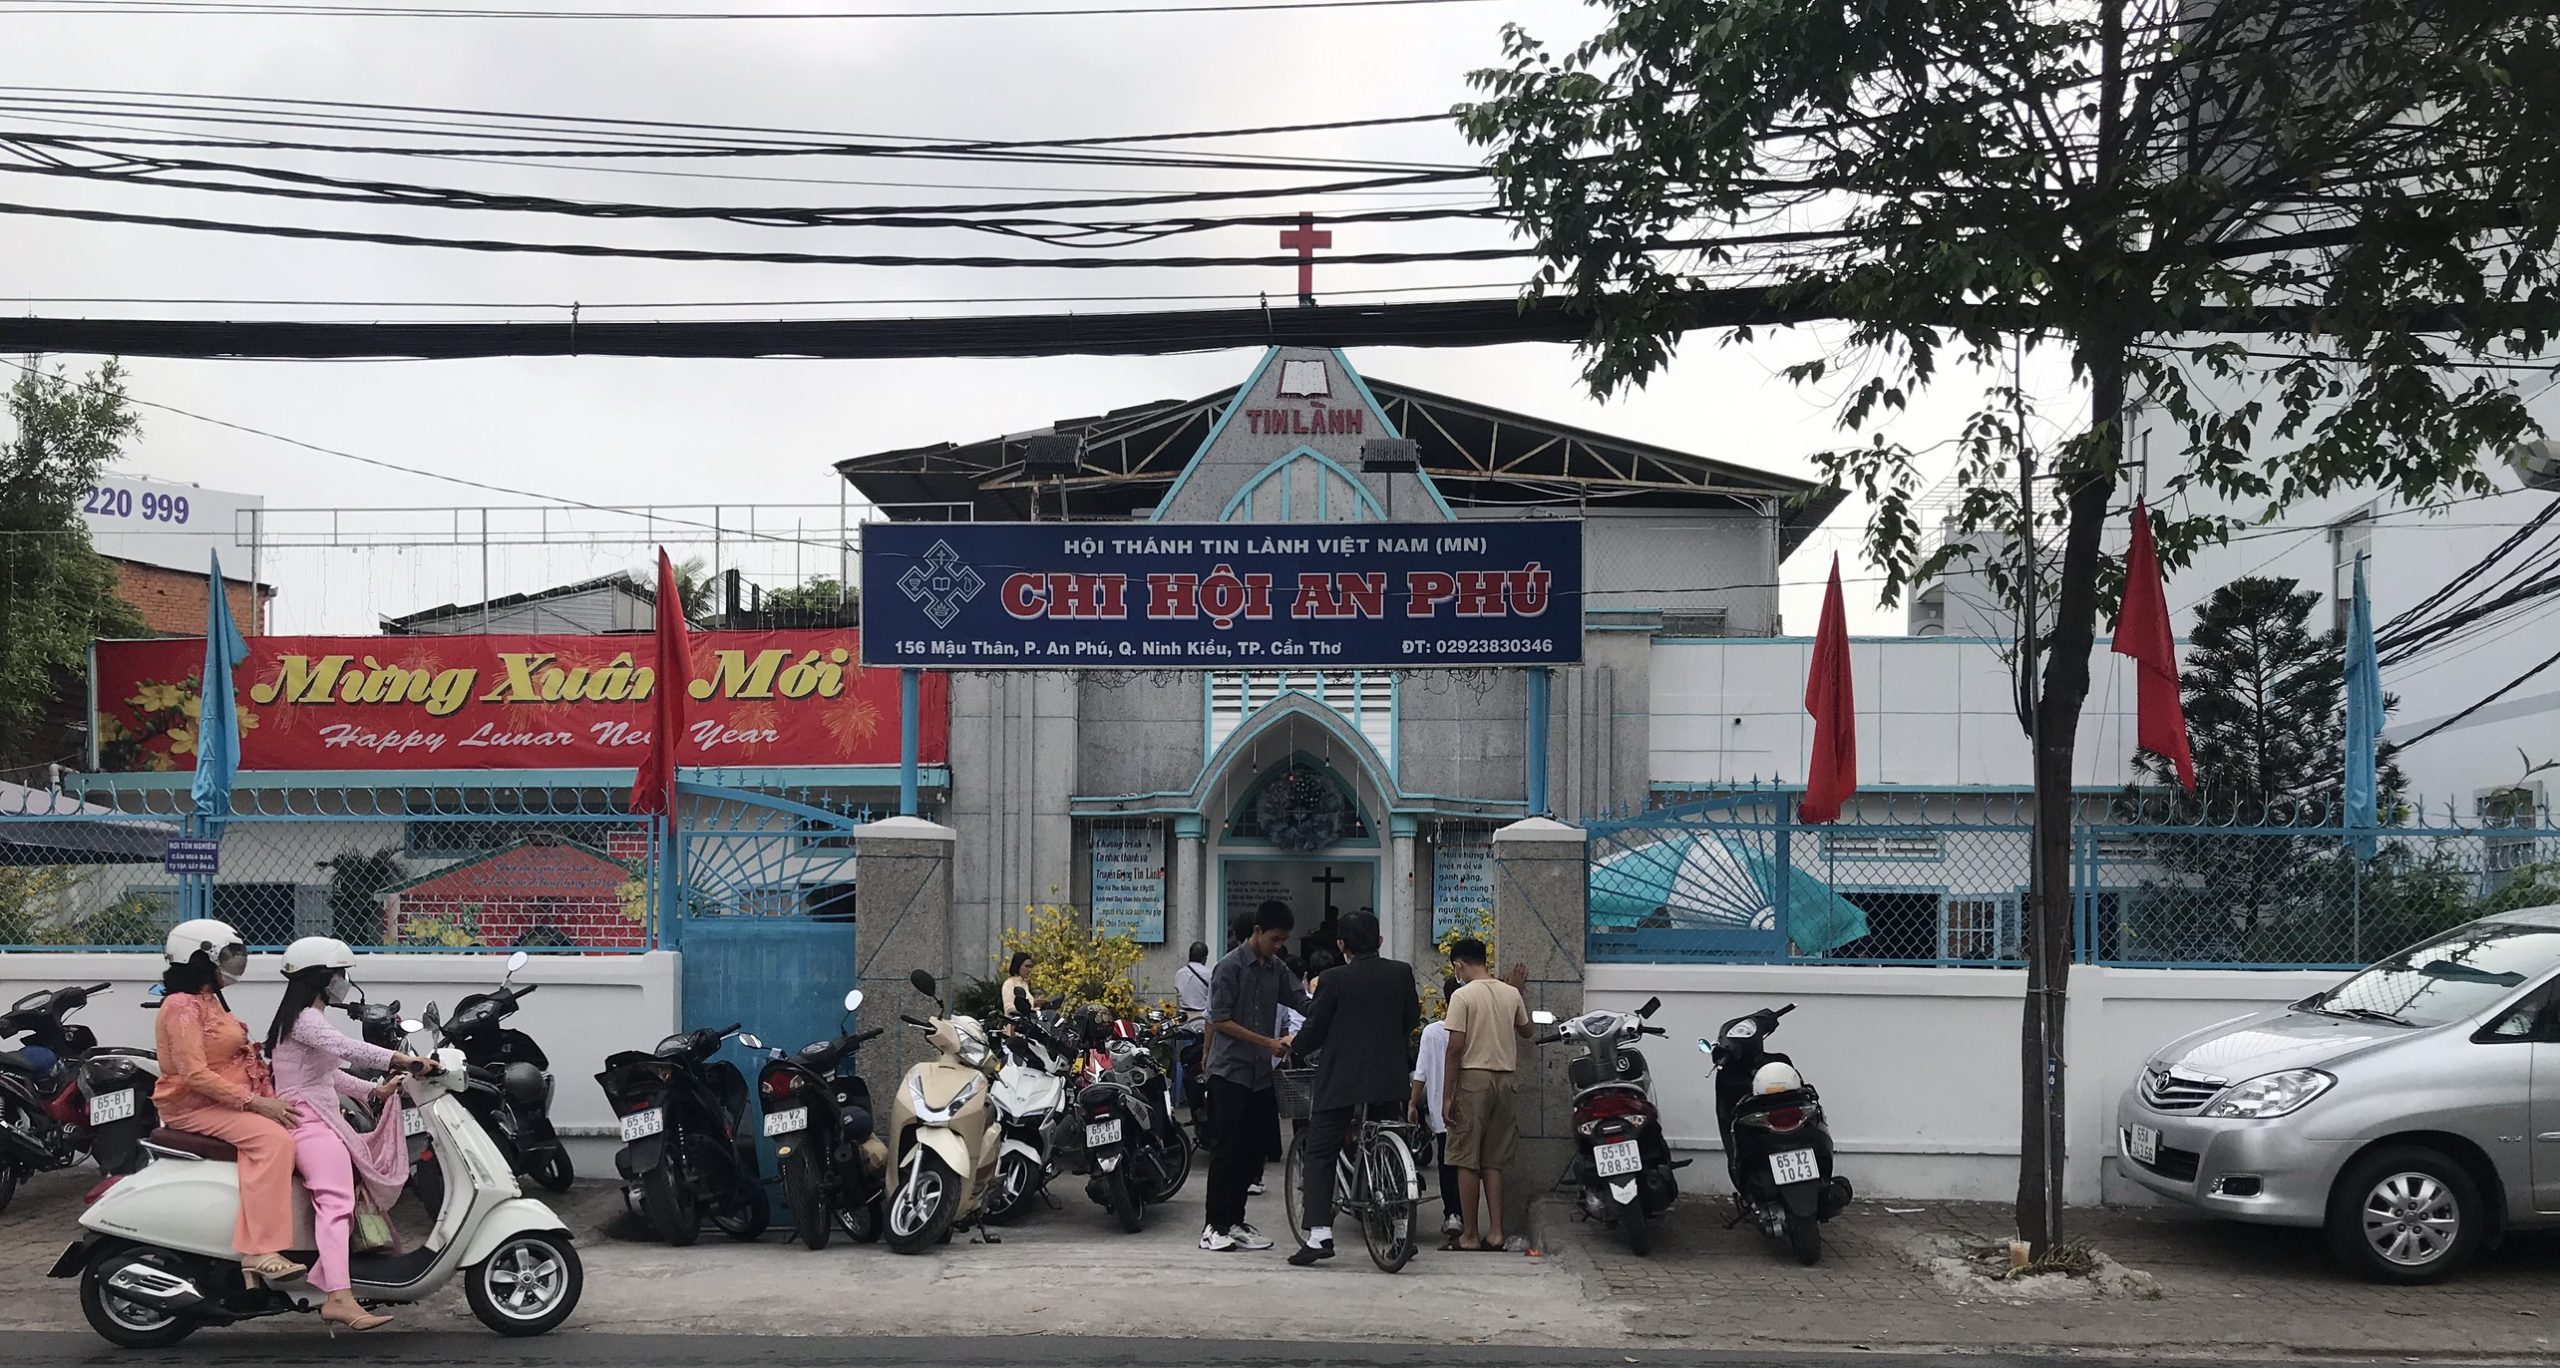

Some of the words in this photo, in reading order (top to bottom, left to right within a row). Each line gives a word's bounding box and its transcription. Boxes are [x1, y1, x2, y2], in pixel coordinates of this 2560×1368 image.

[1246, 409, 1288, 434] TIN
[1292, 401, 1363, 434] LÀNH
[83, 486, 132, 518] 220
[142, 492, 189, 524] 999
[1064, 538, 1104, 558] HỘI
[1112, 538, 1193, 555] THÁNH
[1201, 539, 1239, 554] TIN
[1247, 536, 1309, 554] LÀNH
[1316, 537, 1370, 557] VIỆT
[1377, 538, 1429, 553] NAM
[1436, 537, 1488, 555] (MN)
[1001, 573, 1128, 621] CHI
[1147, 563, 1272, 630] HỘI
[1291, 572, 1387, 620] AN
[1407, 562, 1551, 619] PHÚ
[895, 641, 926, 655] 156
[931, 641, 966, 661] Mậu
[971, 641, 1019, 658] Thân,
[1025, 641, 1041, 655] P.
[1046, 641, 1073, 655] An
[1077, 640, 1113, 658] Phú,
[1118, 641, 1137, 656] Q.
[1142, 641, 1181, 655] Ninh
[1187, 639, 1232, 657] Kiều,
[1237, 642, 1266, 656] TP.
[1270, 638, 1304, 655] Cần
[1309, 641, 1342, 655] Thơ
[1402, 640, 1431, 654] ĐT:
[1436, 639, 1553, 654] 02923830346
[249, 653, 477, 717] Mừng
[479, 652, 656, 703] Xuân
[687, 647, 849, 700] Mới
[319, 723, 447, 753] Happy
[457, 722, 574, 748] Lunar
[590, 720, 651, 747] Ne
[690, 719, 780, 752] Year
[97, 1091, 127, 1110] 65-B1
[93, 1102, 132, 1124] 870.12
[627, 1111, 656, 1127] 65-B2
[771, 1110, 801, 1122] 59-V2
[624, 1120, 661, 1139] 636.93
[767, 1119, 805, 1134] 820.98
[1091, 1120, 1116, 1135] 65-B1
[2137, 1126, 2149, 1142] 65A
[1089, 1130, 1120, 1146] 495.60
[1602, 1143, 1631, 1159] 65-B1
[1777, 1152, 1809, 1168] 65-X2
[2132, 1140, 2153, 1162] 343.66
[1600, 1157, 1640, 1175] 288.35
[1780, 1166, 1812, 1181] 1043
